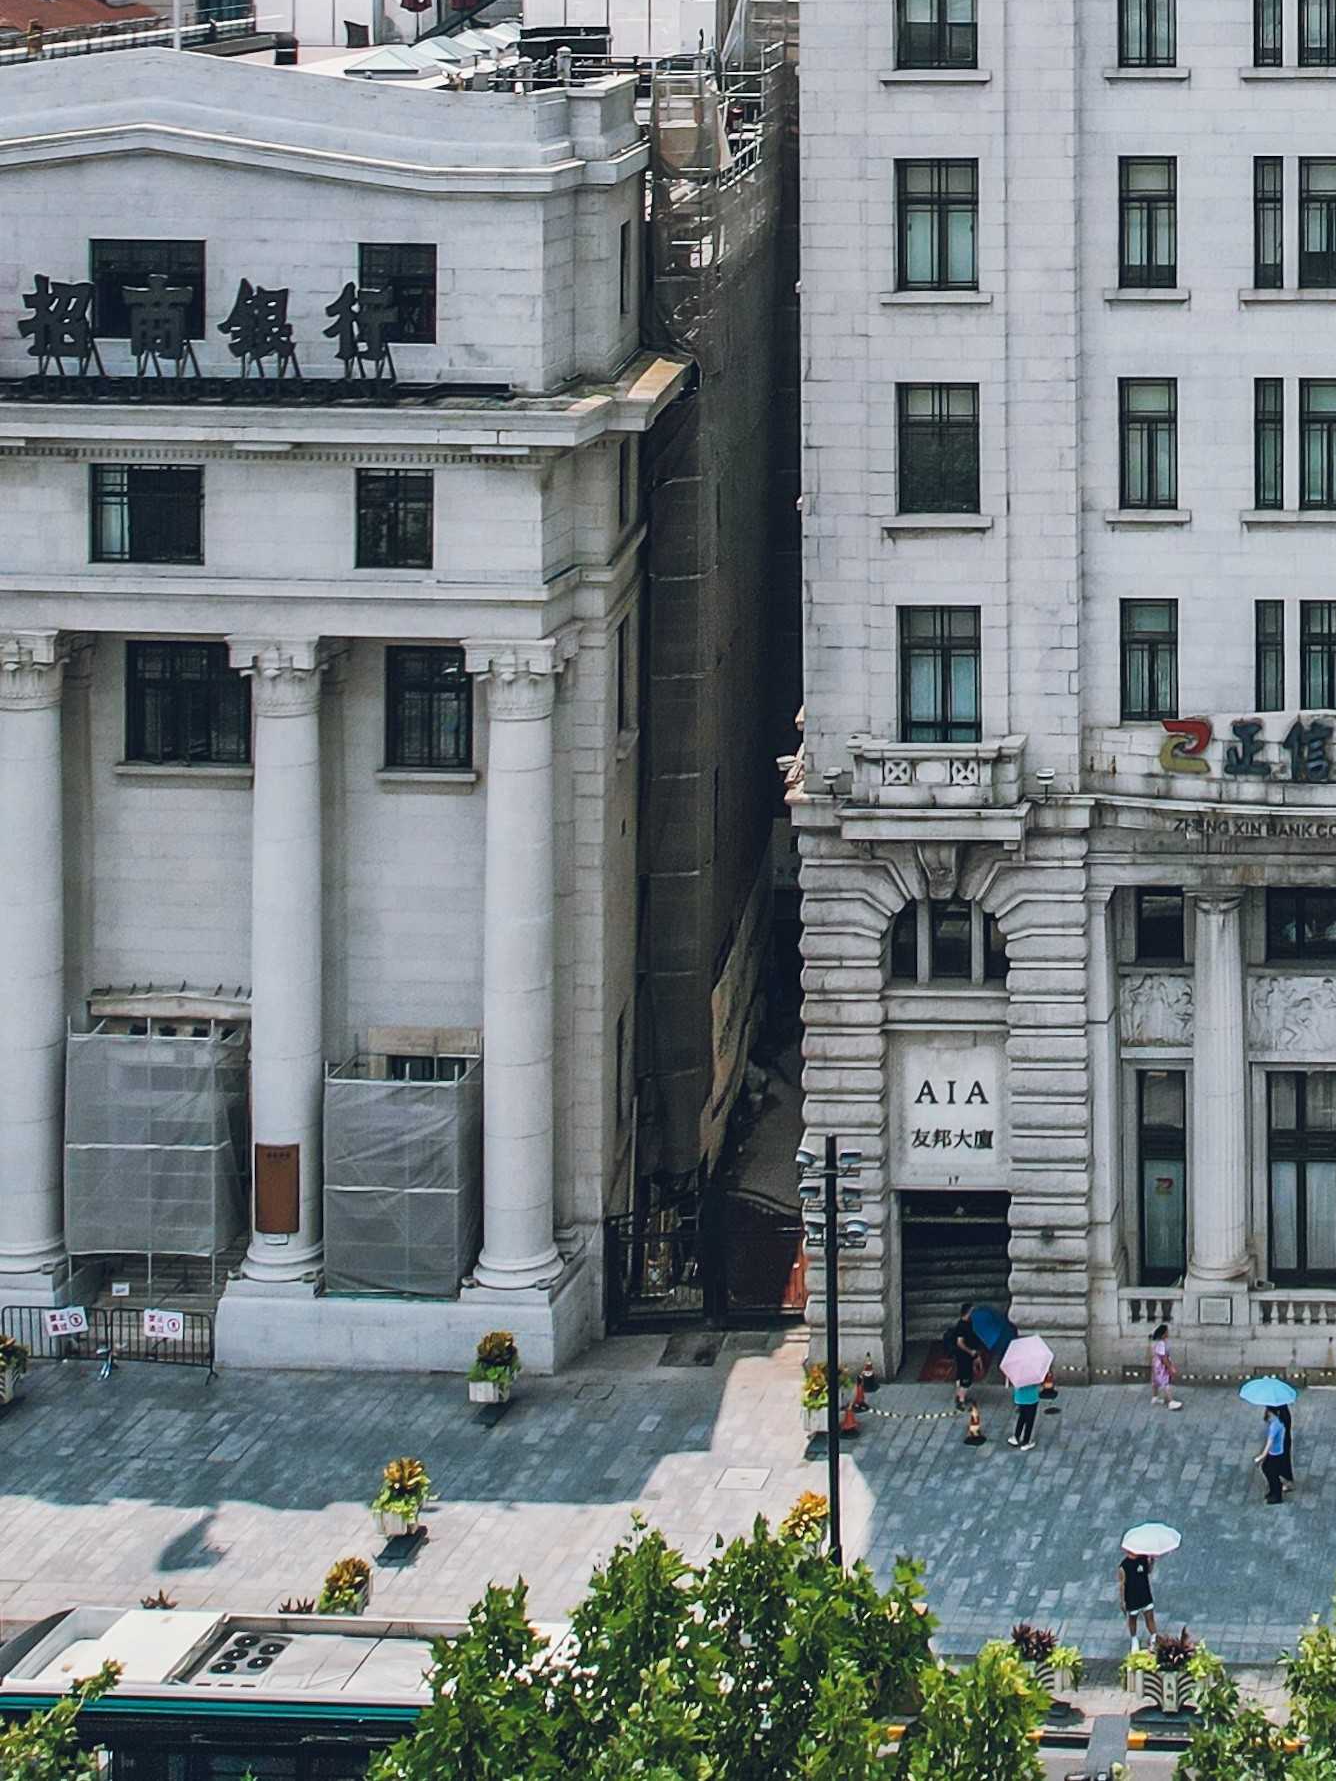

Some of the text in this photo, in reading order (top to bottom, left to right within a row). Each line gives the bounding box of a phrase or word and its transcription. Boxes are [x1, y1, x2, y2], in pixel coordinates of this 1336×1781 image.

[1233, 820, 1262, 835] XIN
[1266, 821, 1312, 836] BANK
[914, 1080, 989, 1105] AIA
